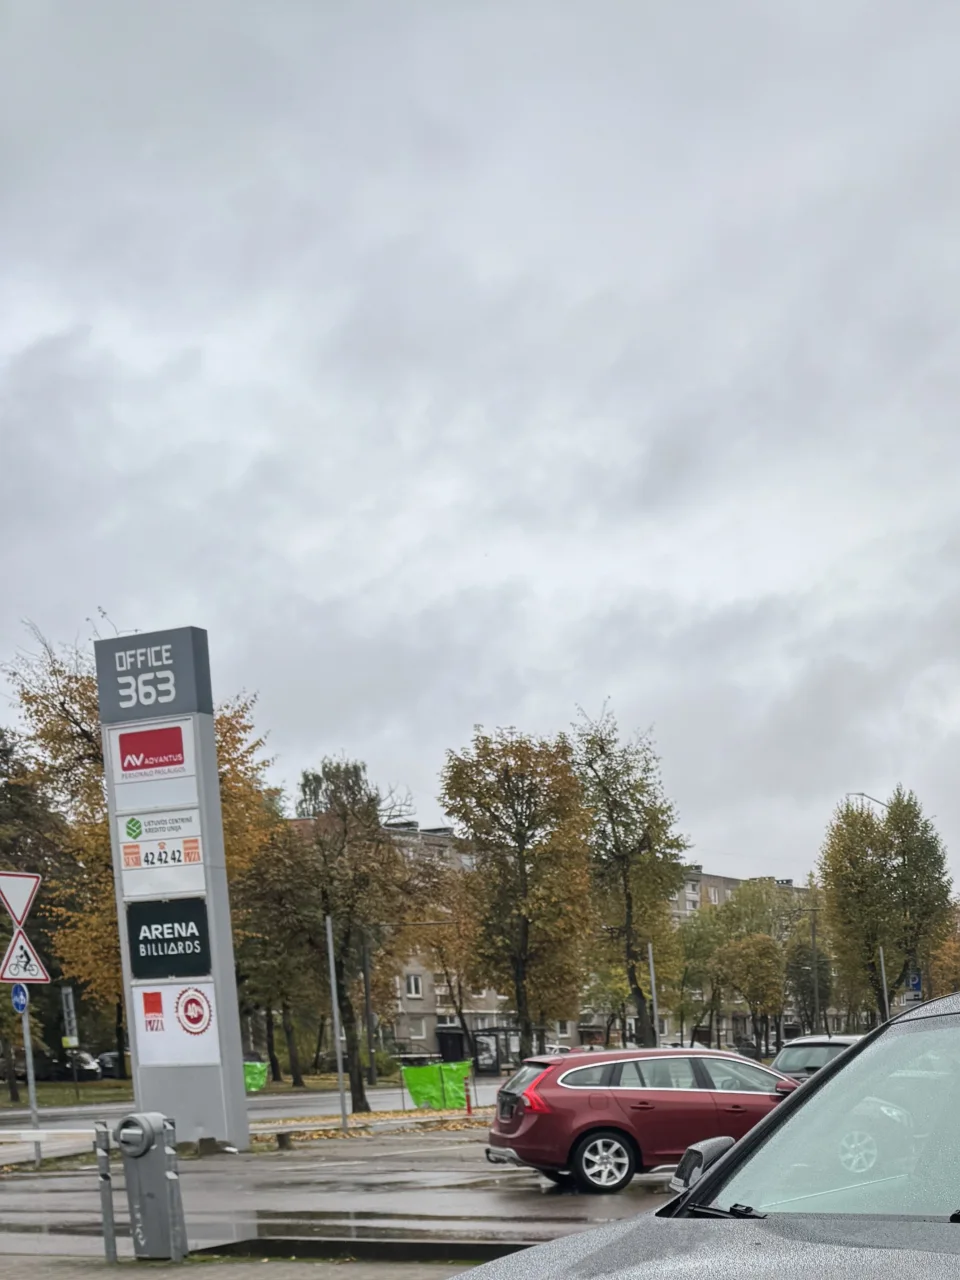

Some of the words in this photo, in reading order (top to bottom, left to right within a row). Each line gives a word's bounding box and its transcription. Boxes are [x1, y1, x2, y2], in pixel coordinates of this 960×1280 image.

[115, 644, 173, 672] OFFICE
[117, 670, 176, 708] 363
[144, 753, 183, 765] ADVANTUS
[144, 852, 156, 865] 42
[157, 851, 169, 864] 42
[170, 849, 182, 863] 42
[138, 921, 199, 941] ARENA
[139, 939, 201, 957] BILLIARDS
